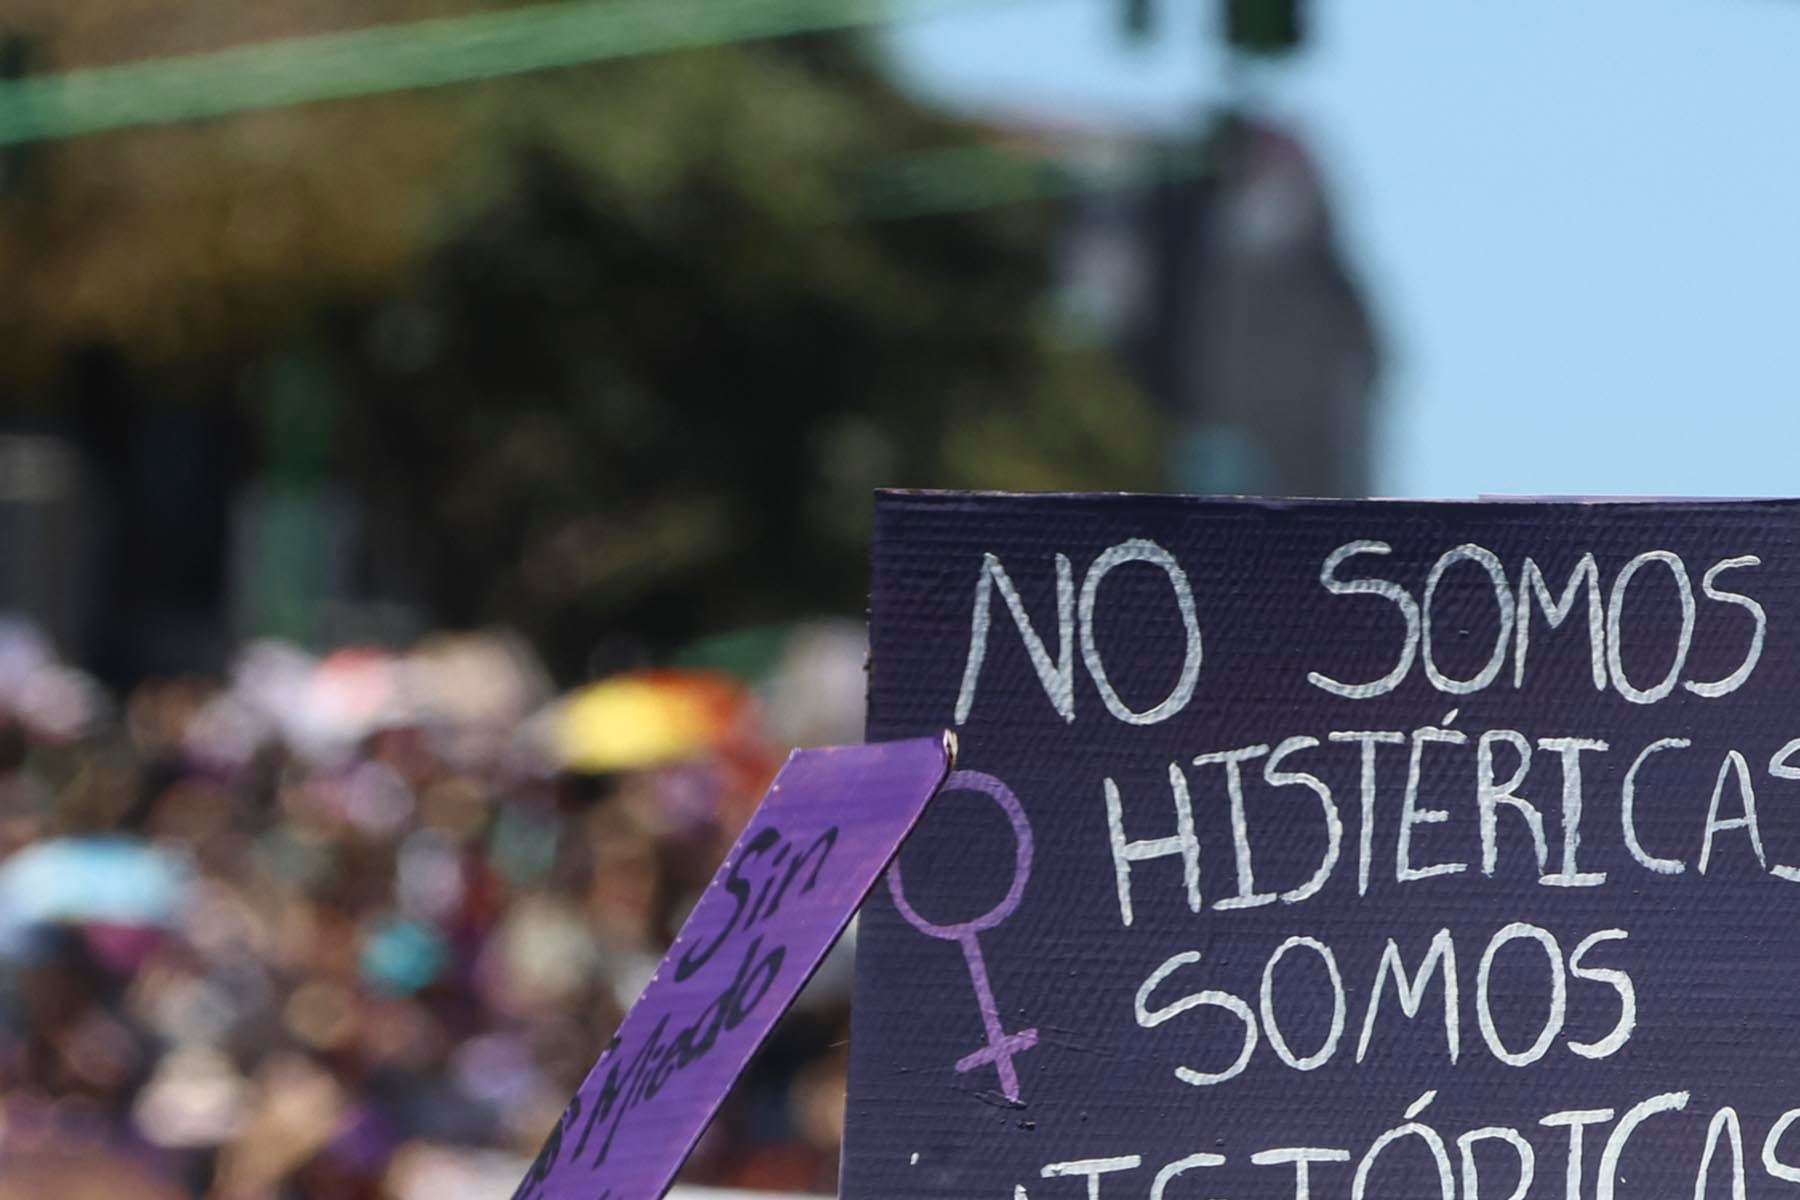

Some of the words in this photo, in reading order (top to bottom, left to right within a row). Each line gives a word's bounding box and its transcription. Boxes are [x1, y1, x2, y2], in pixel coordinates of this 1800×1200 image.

[953, 537, 1204, 727] NO
[1306, 539, 1768, 706] SOMOS
[674, 826, 839, 983] Sin
[570, 935, 787, 1172] Miedo
[1134, 921, 1639, 1087] SOMOS
